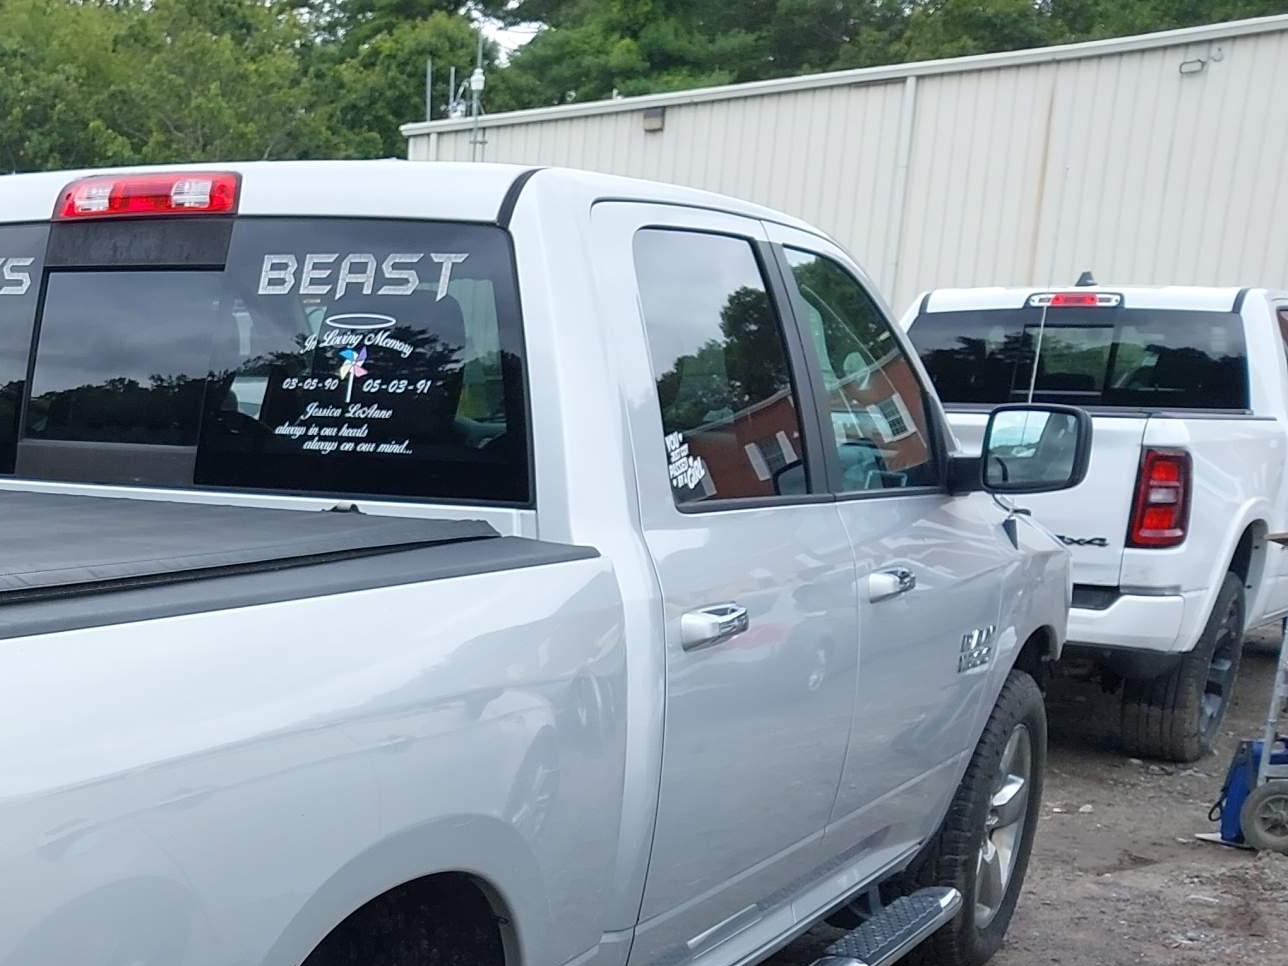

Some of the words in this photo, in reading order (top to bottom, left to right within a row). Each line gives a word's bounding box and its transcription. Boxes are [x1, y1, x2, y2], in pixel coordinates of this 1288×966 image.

[257, 253, 470, 302] BEAST
[318, 329, 364, 348] Loving
[364, 331, 413, 358] Memory
[282, 378, 339, 390] 03-05-90
[362, 379, 433, 394] 05-03-91
[300, 402, 343, 420] Jessica
[274, 421, 306, 439] always
[307, 424, 318, 436] in
[319, 427, 338, 436] our
[338, 423, 369, 438] hearts
[302, 437, 338, 454] always
[340, 442, 354, 451] on
[356, 442, 374, 452] our
